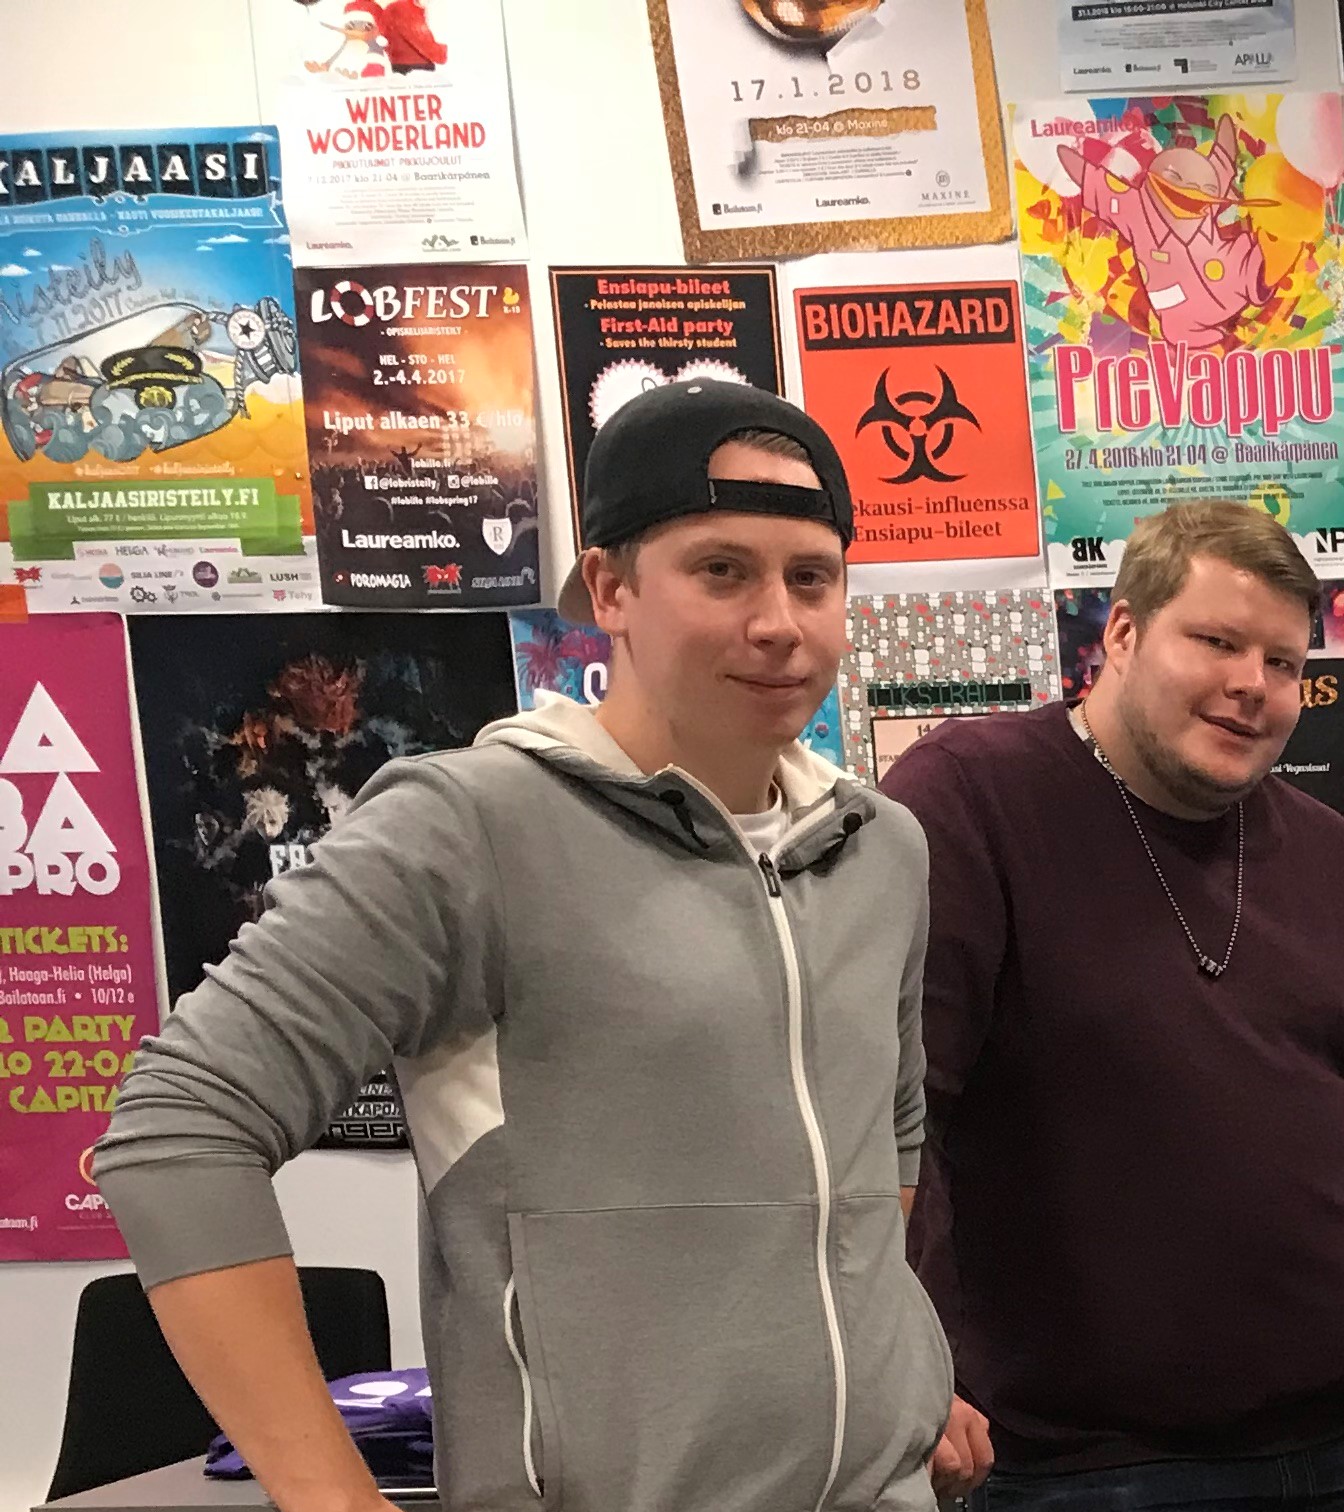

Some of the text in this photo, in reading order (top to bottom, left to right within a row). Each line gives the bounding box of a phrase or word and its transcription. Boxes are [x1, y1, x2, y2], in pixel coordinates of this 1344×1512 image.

[731, 69, 921, 101] 17.1.2018
[346, 94, 443, 124] WINTER
[307, 122, 486, 154] WONDERLAND
[597, 278, 730, 298] Ensiapu-bileet
[600, 316, 733, 336] First-Aid party
[804, 298, 1009, 341] BIOHAZARD
[1054, 340, 1334, 438] PreVappu
[324, 410, 441, 435] Liput alkaen
[1065, 445, 1207, 470] 27.4.2016 21-04
[48, 488, 259, 509] KALJAASIRISTEILY.FI
[341, 529, 460, 549] Laureamko.
[853, 519, 1002, 543] Ensiapu-bileet
[351, 574, 412, 588] POROMAGIA
[9, 964, 132, 984] Haaga-Helia (Helga)
[24, 1014, 136, 1043] PARTY
